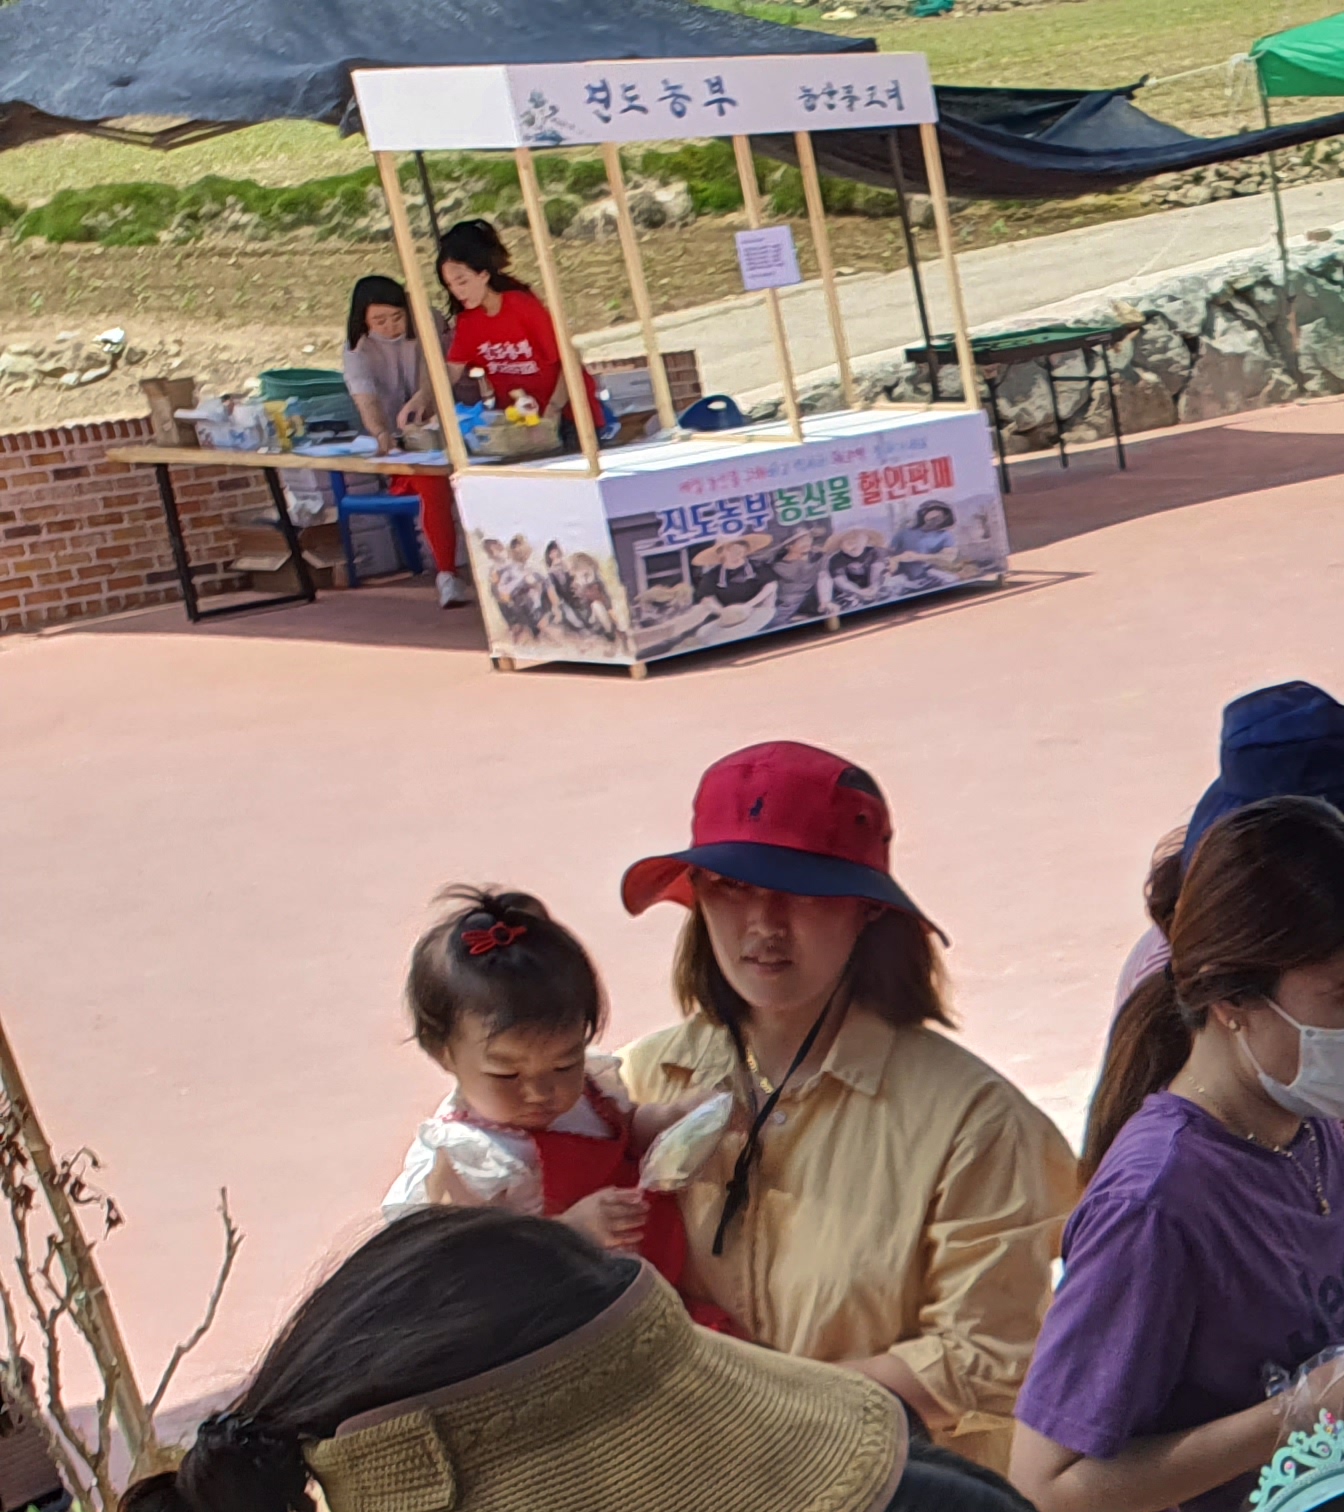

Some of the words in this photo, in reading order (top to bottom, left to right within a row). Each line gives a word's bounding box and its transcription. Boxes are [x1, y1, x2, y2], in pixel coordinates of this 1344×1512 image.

[660, 493, 769, 545] 진도농부
[775, 475, 853, 524] 농산물
[857, 455, 955, 506] 할인판매
